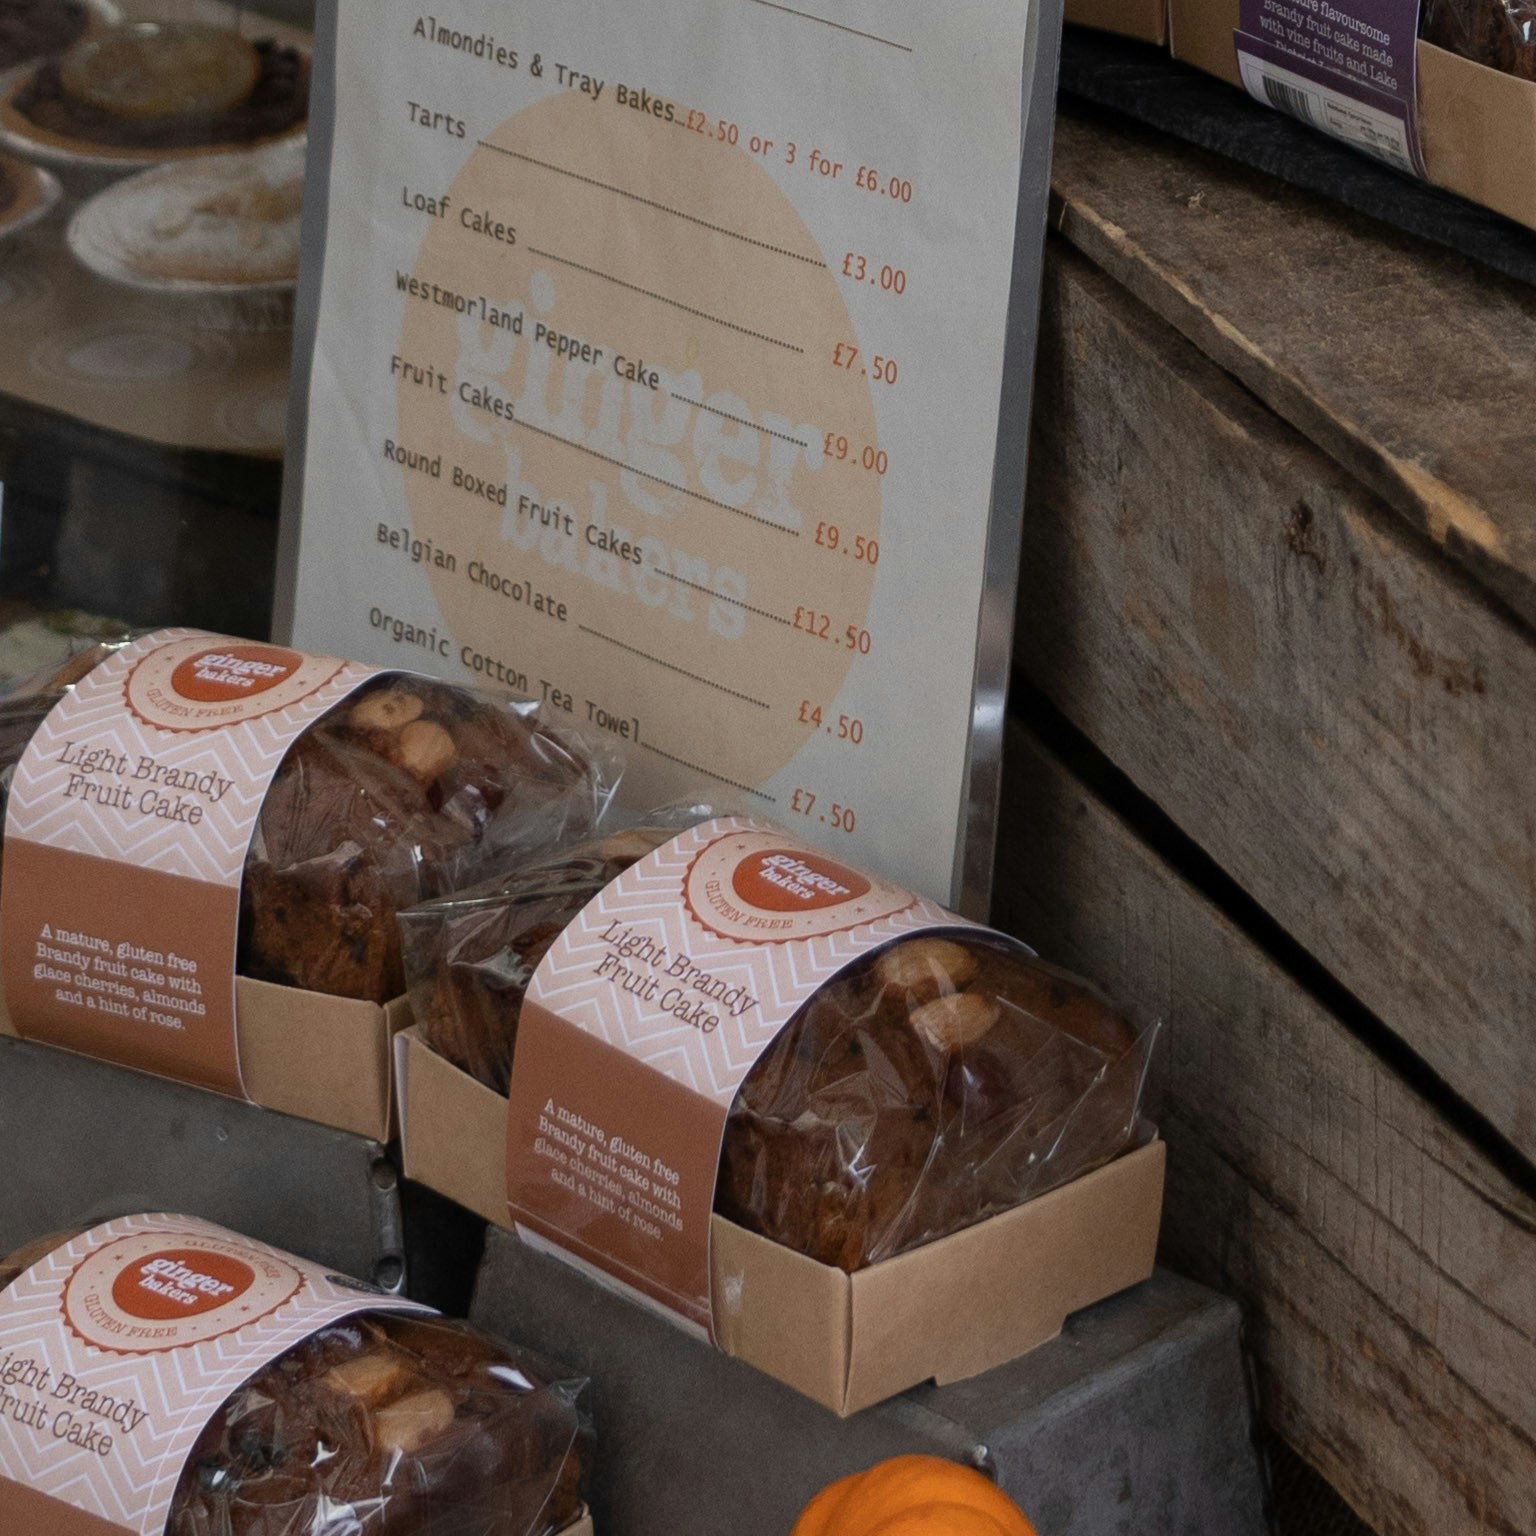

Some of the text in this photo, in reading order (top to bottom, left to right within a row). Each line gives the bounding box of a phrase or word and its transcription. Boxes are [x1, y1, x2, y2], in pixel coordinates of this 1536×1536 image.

[413, 16, 914, 205] Almondies & Tray Bakes £2.50 or 3 for £6.00
[407, 100, 908, 296] Tarts £3.00
[401, 186, 899, 386] Loaf Cakes £7.50
[395, 269, 889, 476] Westmorland Pepper Cake £9.00
[450, 269, 825, 525] ginger
[390, 355, 881, 567] Fruit Cakes £9.50
[384, 439, 873, 656] Round Boxed Fruit Cakes £12.50
[503, 441, 747, 641] bakers
[193, 653, 287, 677] ginger
[376, 522, 865, 746] Belgian Chocolate £4.50
[195, 667, 255, 687] bakers
[368, 606, 858, 834] Organic Cotton Tea Towel £7.50
[57, 741, 235, 804] Light Brandy
[63, 774, 205, 826] Fruit Cake
[705, 879, 794, 928] GLUTEN FREE
[758, 865, 815, 899] bakers
[761, 854, 851, 896] ginger
[36, 942, 202, 994] Brandy fruit cake with
[40, 923, 198, 973] A mature, gluten free
[598, 919, 759, 1018] Light Brandy
[33, 963, 206, 1015] glace cherries, almonds
[56, 988, 186, 1030] and a hint of rose.
[592, 952, 720, 1035] Fruit Cake
[139, 1274, 198, 1304] bakers
[140, 1258, 234, 1296] ginger
[0, 1353, 149, 1434] ight Brandy
[52, 1411, 114, 1457] Cake
